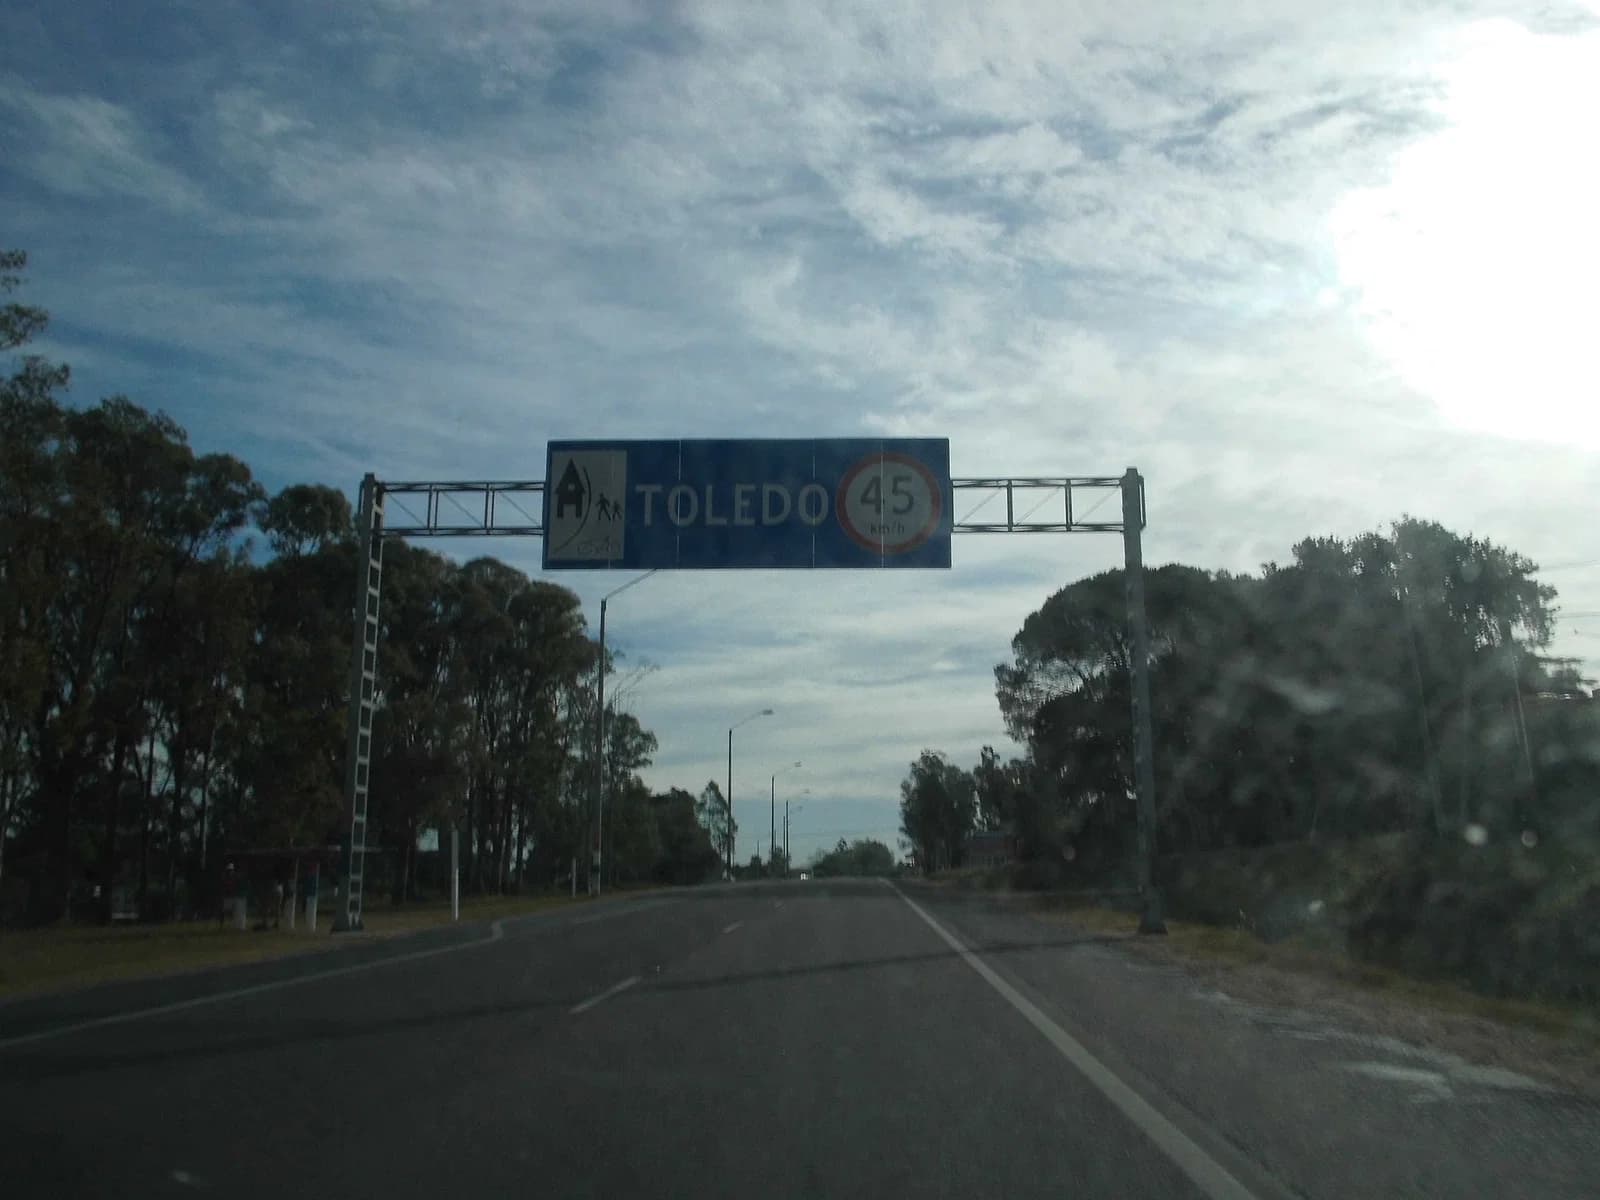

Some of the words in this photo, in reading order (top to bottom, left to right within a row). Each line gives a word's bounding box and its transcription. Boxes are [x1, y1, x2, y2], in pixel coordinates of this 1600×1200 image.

[636, 484, 828, 526] TOLEDO
[860, 475, 915, 516] 45
[868, 521, 905, 535] km/h
